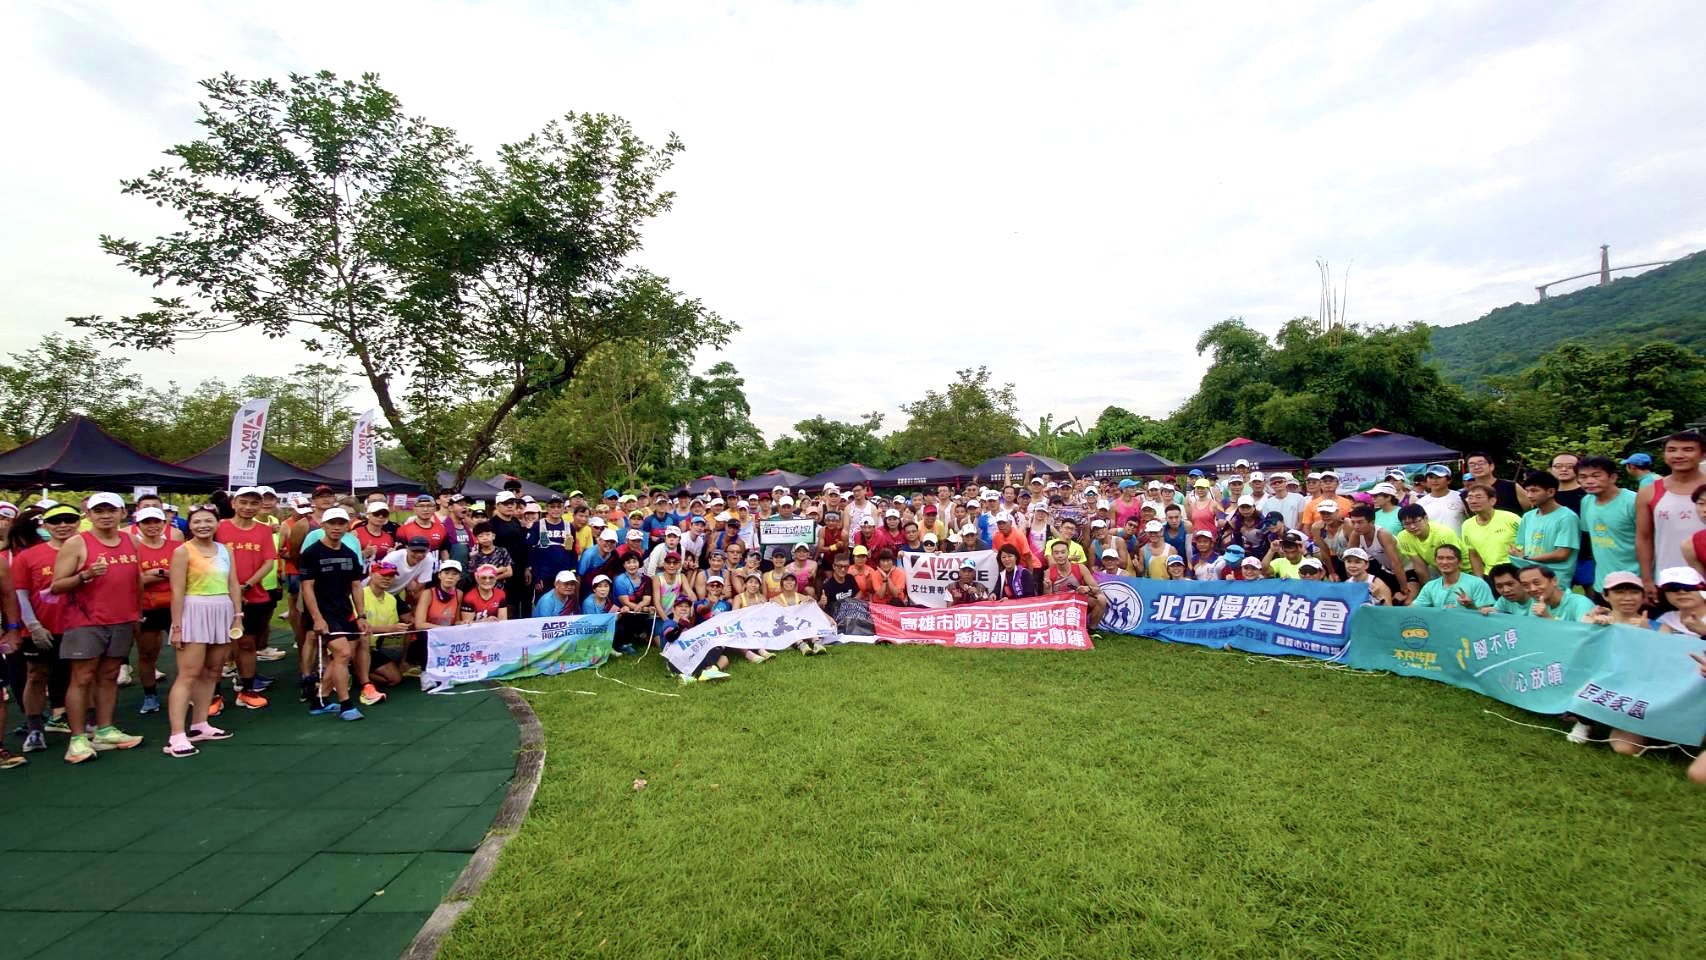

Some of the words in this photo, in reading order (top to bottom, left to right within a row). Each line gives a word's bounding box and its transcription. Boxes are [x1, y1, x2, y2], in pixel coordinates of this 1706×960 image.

[936, 570, 989, 582] ZOE
[911, 584, 949, 596] 艾仕寶專
[901, 606, 1081, 632] 高雄市阿公店長跑協會
[1150, 594, 1349, 635] 北回慢跑協會
[450, 641, 471, 655] 2026
